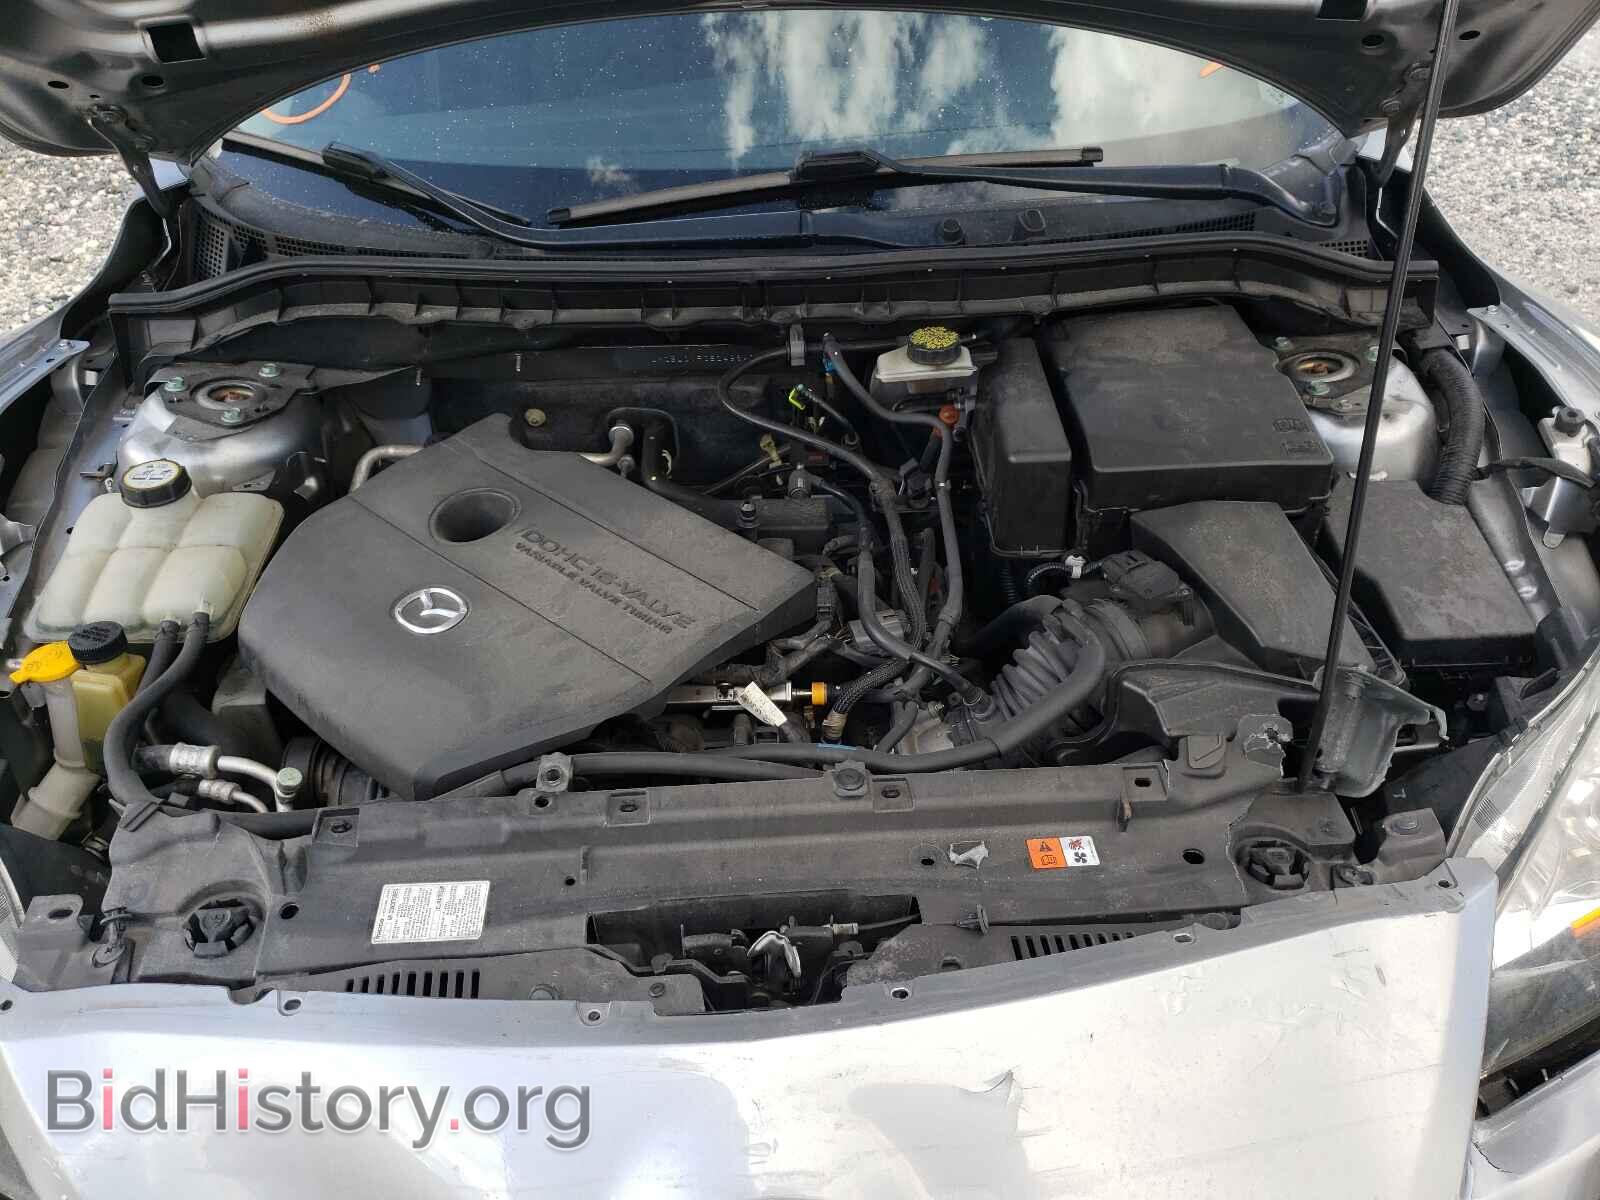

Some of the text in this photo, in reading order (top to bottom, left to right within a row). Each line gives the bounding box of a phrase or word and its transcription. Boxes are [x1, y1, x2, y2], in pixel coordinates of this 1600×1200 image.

[520, 529, 594, 572] DOHC
[515, 542, 673, 634] VARIABLE VALVE TIMING
